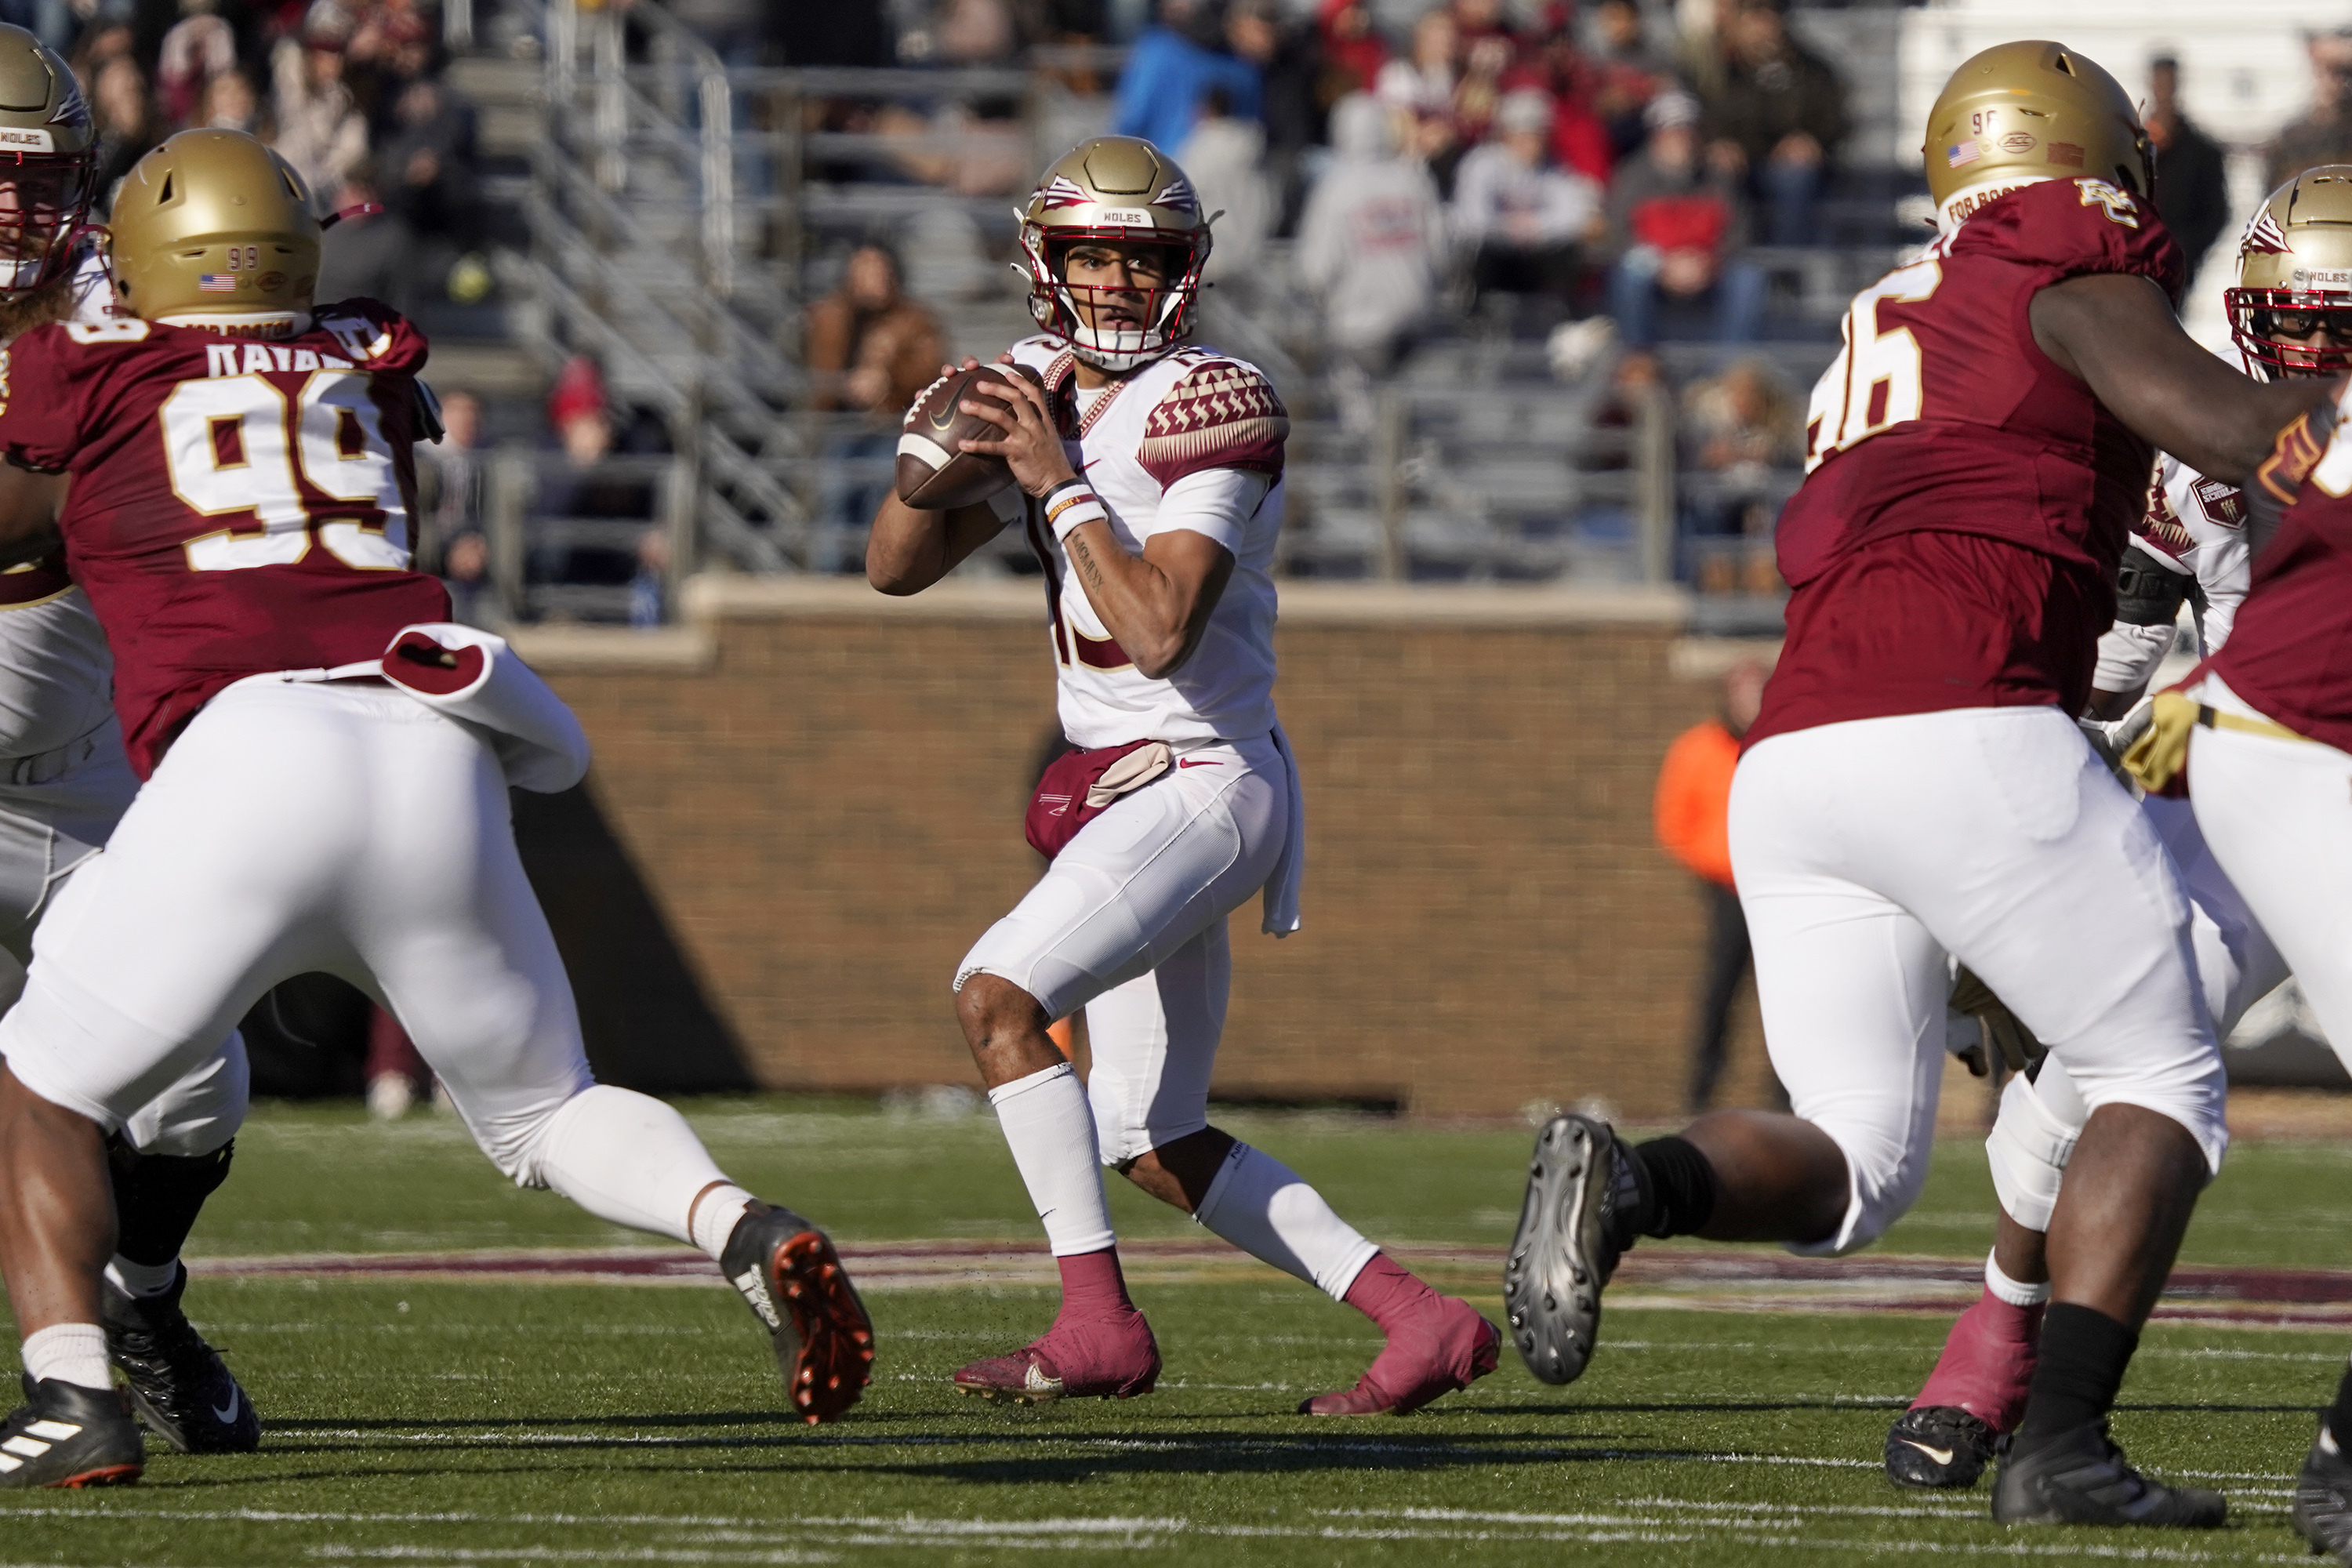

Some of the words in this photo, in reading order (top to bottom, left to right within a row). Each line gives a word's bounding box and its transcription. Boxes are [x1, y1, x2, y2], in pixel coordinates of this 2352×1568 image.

[1, 132, 41, 145] NOLES
[1104, 212, 1142, 223] NOLES
[1948, 196, 1974, 223] FOR
[227, 245, 260, 271] 99
[2310, 271, 2348, 282] NOLES
[159, 369, 412, 572] 99
